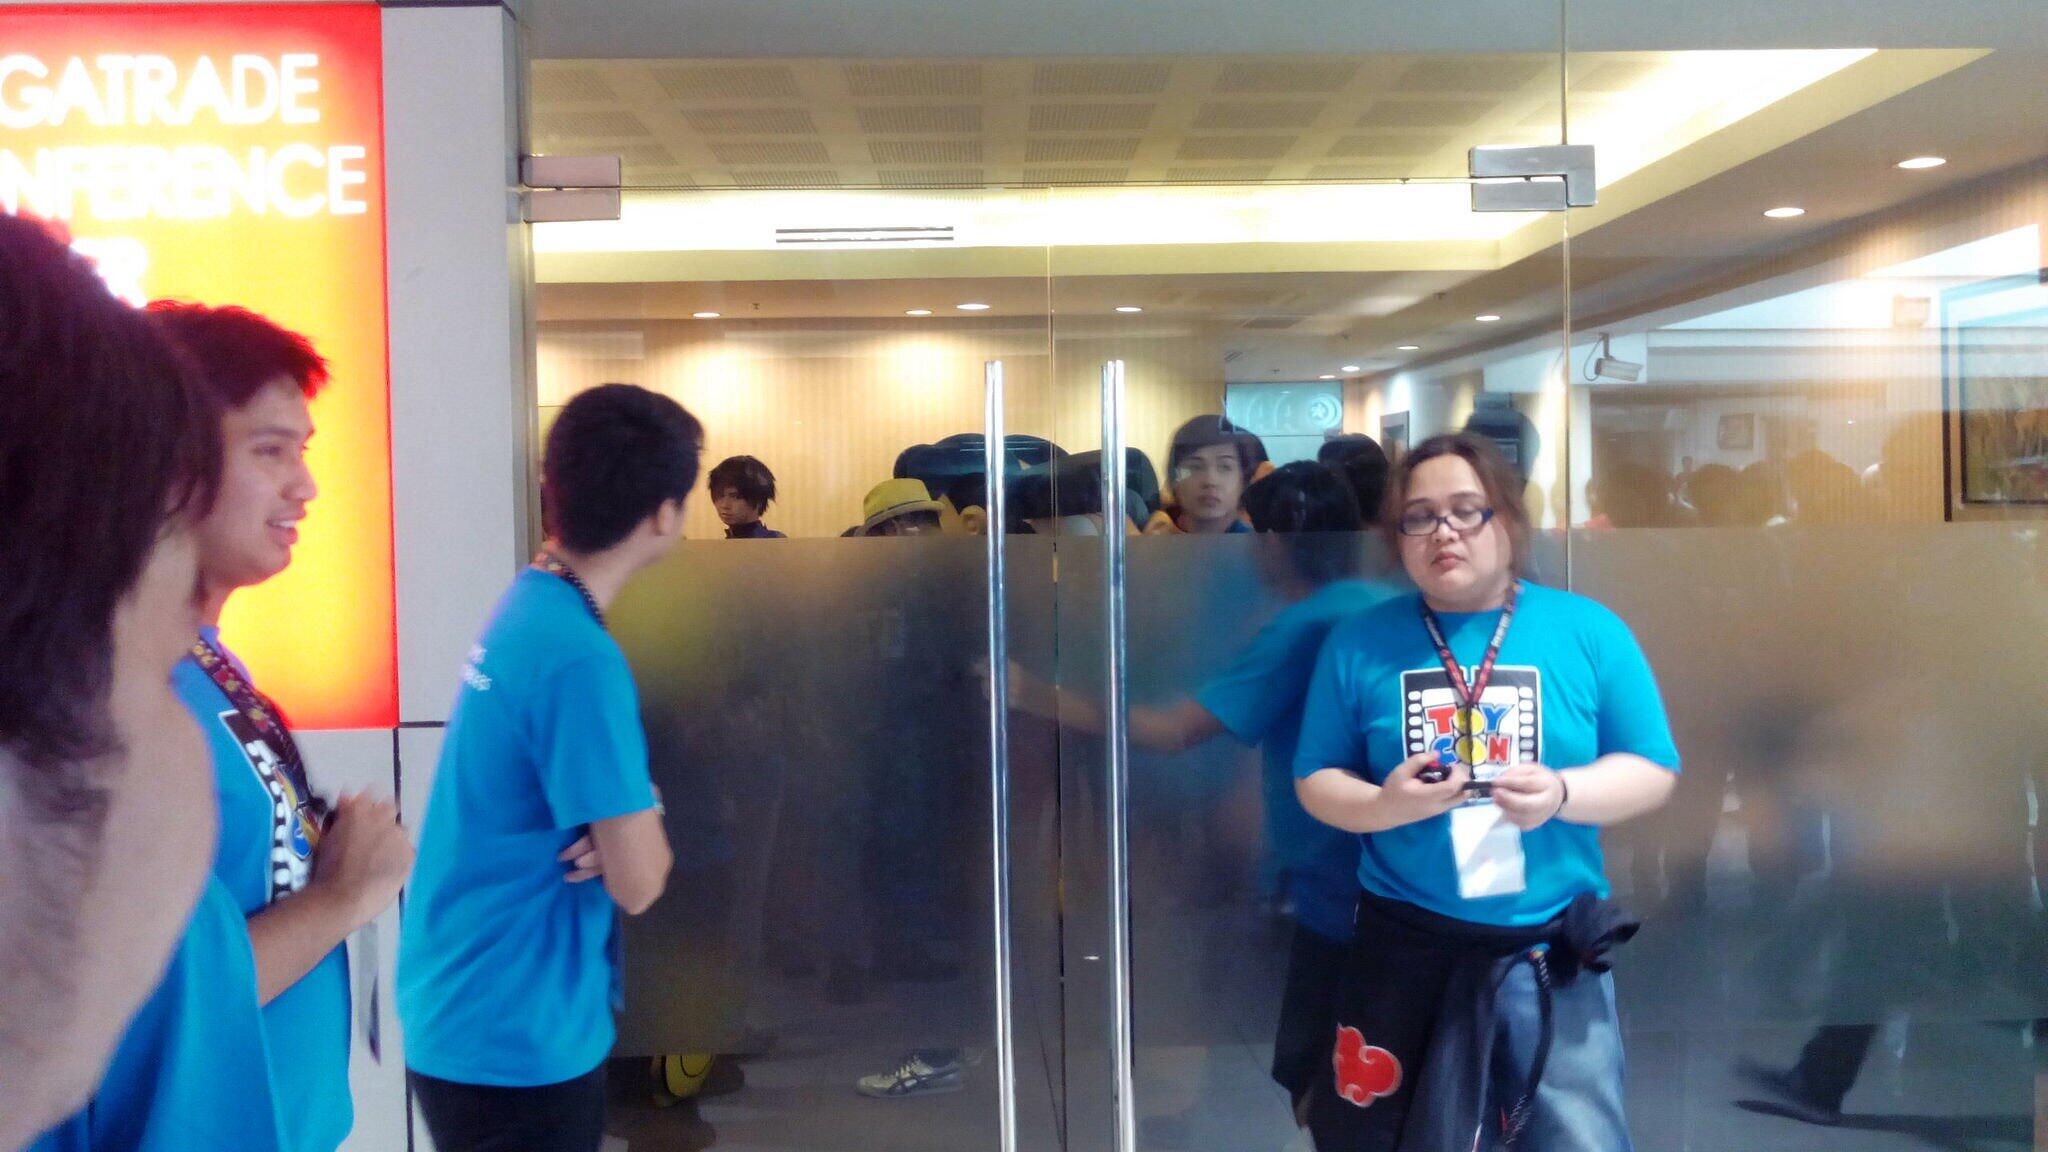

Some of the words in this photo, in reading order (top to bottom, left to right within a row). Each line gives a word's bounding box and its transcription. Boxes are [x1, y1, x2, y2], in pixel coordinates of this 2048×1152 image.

[0, 54, 320, 127] GATRADE
[1426, 703, 1515, 737] TOY
[1430, 734, 1511, 766] CON
